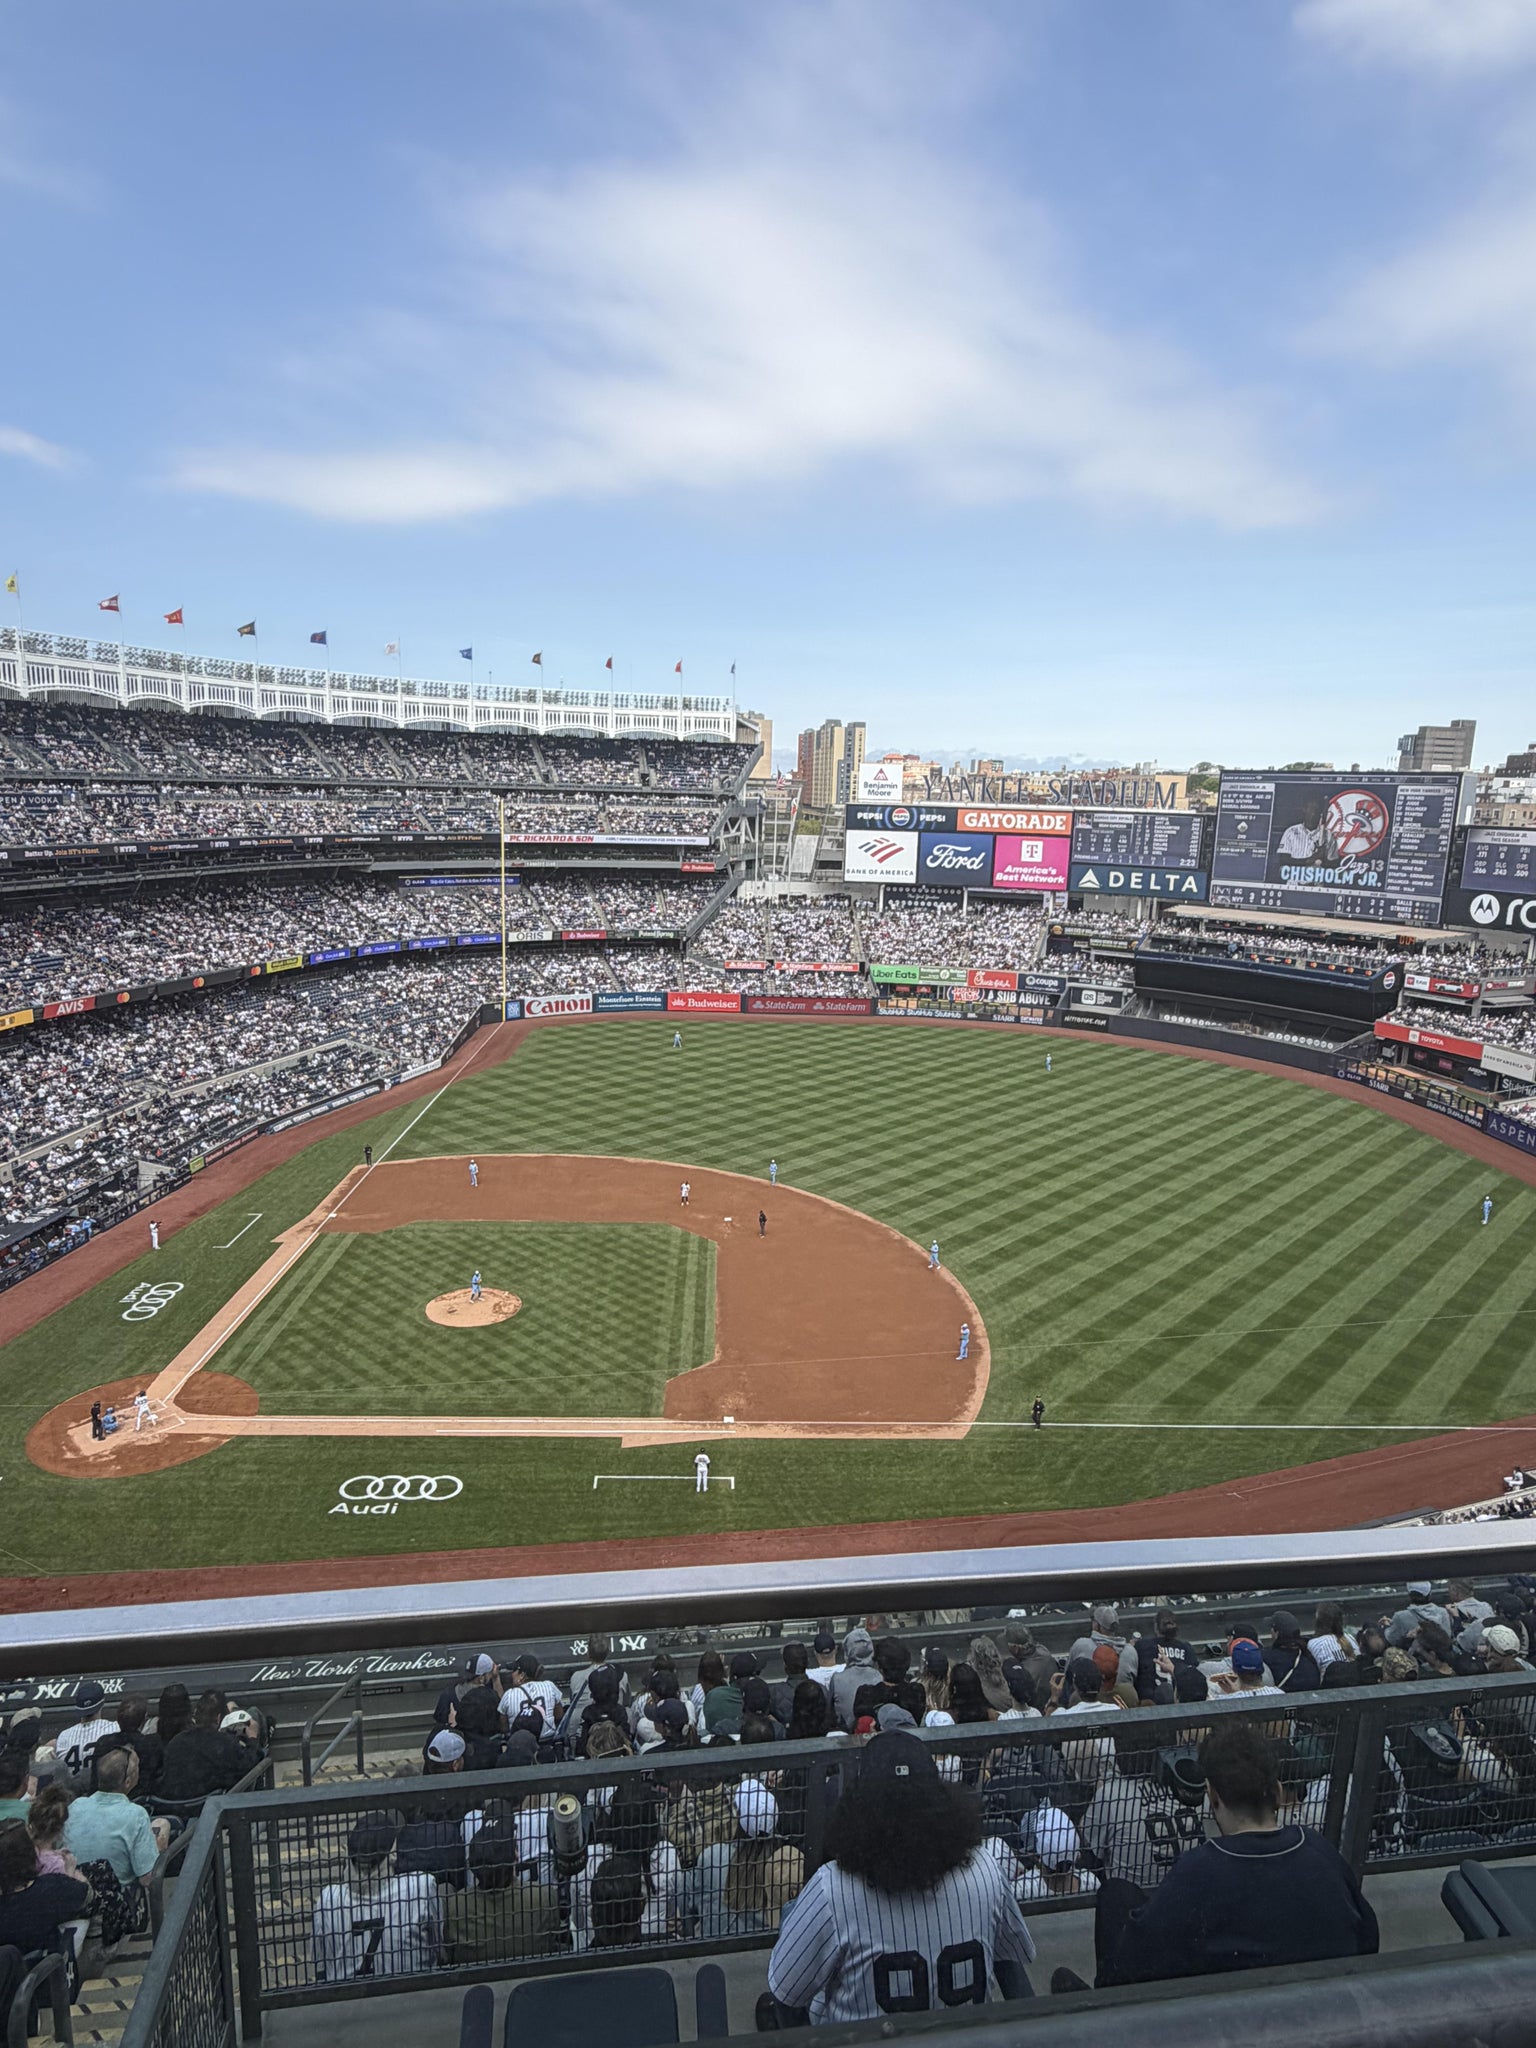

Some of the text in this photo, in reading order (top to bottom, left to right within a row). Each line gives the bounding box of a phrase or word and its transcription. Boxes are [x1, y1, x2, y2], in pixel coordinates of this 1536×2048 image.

[863, 782, 898, 791] Benjamin
[923, 775, 1179, 809] YANKEE STADIUM
[867, 789, 891, 797] Moore
[857, 812, 883, 820] PEPSI
[920, 814, 946, 822] PEPSI
[964, 813, 1066, 830] GATORADE
[926, 844, 986, 870] Ford
[1004, 864, 1057, 875] America's
[1337, 854, 1384, 874] Jazz 13
[996, 872, 1065, 884] Best Network
[1108, 871, 1198, 893] DELTA
[1280, 865, 1382, 887] CHISHOLM JR.
[872, 969, 894, 979] Uber
[896, 971, 917, 980] Eats
[1036, 976, 1058, 986] coupa
[765, 1000, 806, 1010] StateFarm
[997, 993, 1016, 1003] SUB
[1019, 994, 1051, 1005] ABOVE
[56, 1000, 84, 1016] AVIS
[526, 998, 591, 1015] Canon
[825, 1002, 866, 1011] StateFarm
[935, 1010, 961, 1018] StubHub
[1421, 1035, 1444, 1046] TOYOTA
[1503, 1058, 1523, 1068] AMERICA
[1490, 1118, 1535, 1146] ASPEN
[119, 1282, 152, 1303] Audi
[328, 1502, 399, 1515] Audi
[249, 1652, 456, 1682] New York Yankees
